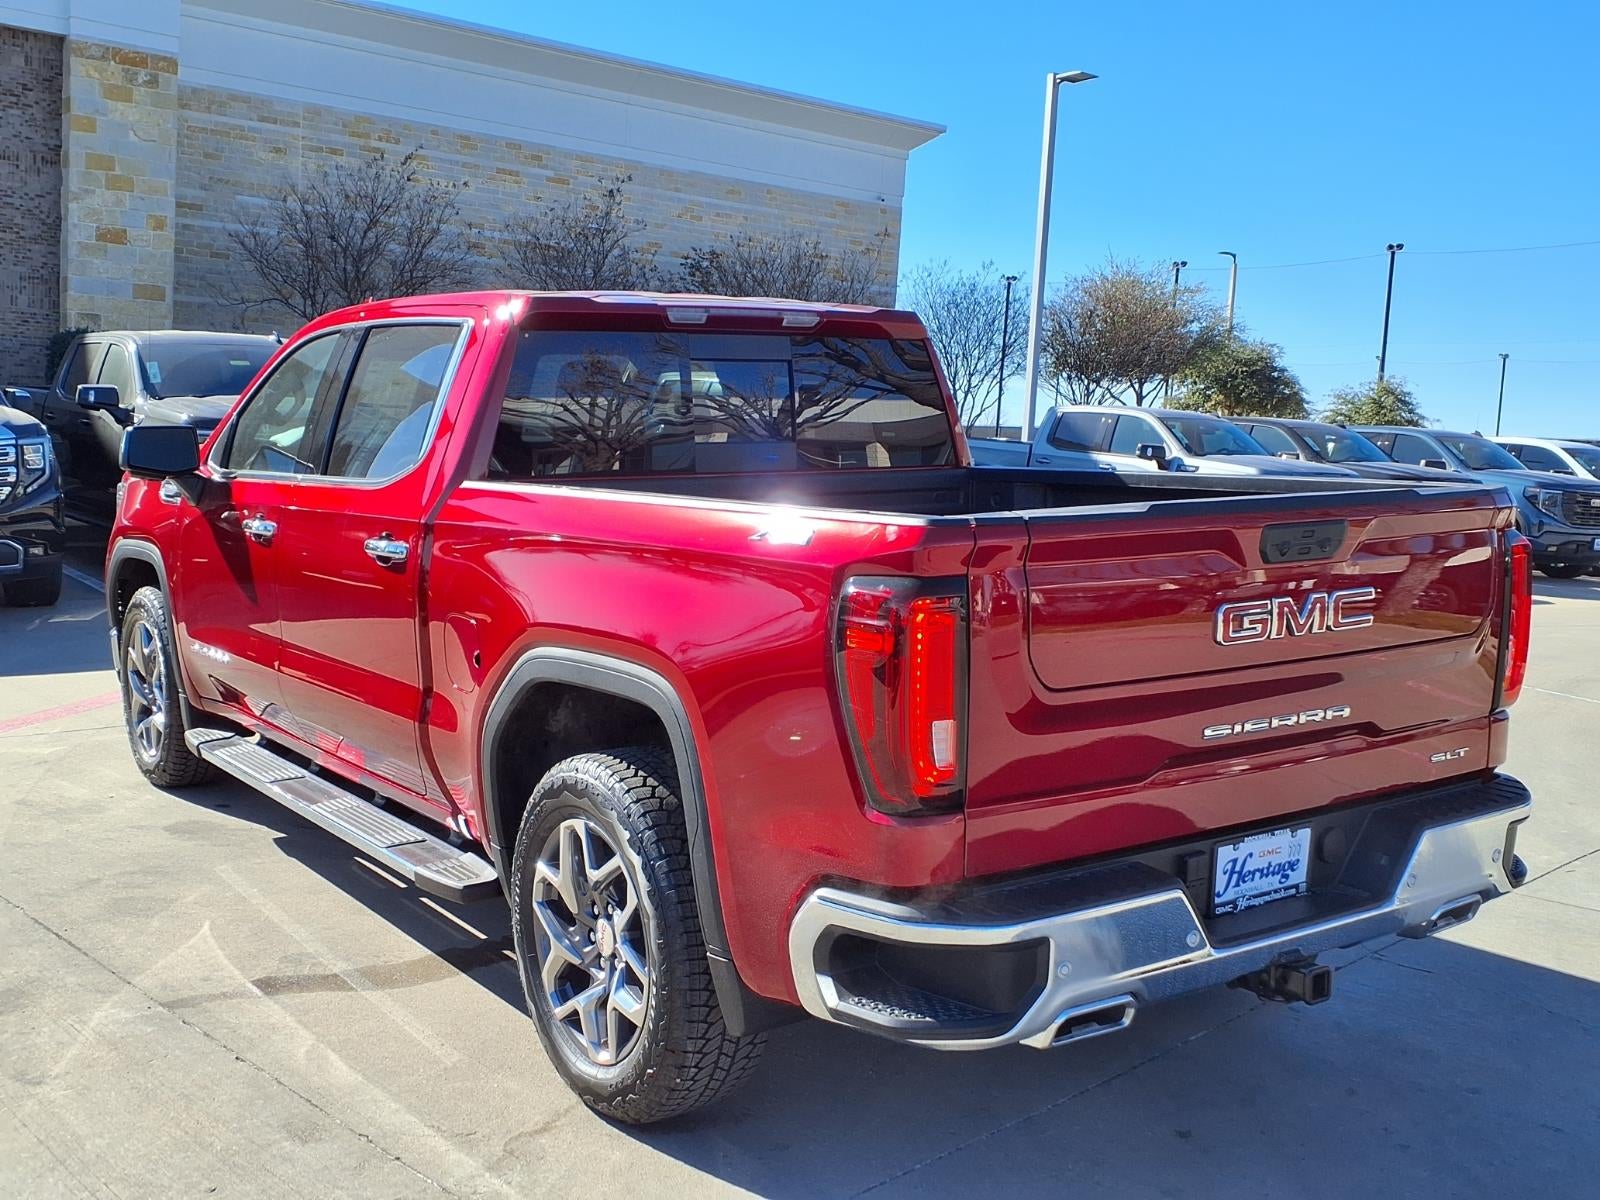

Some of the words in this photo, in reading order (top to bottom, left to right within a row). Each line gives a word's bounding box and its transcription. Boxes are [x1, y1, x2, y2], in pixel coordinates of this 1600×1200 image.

[1215, 586, 1376, 646] GMC
[1202, 704, 1351, 740] SIERRA
[1430, 747, 1469, 763] SLT
[1258, 846, 1282, 858] GMC
[1216, 851, 1300, 898] Heritage
